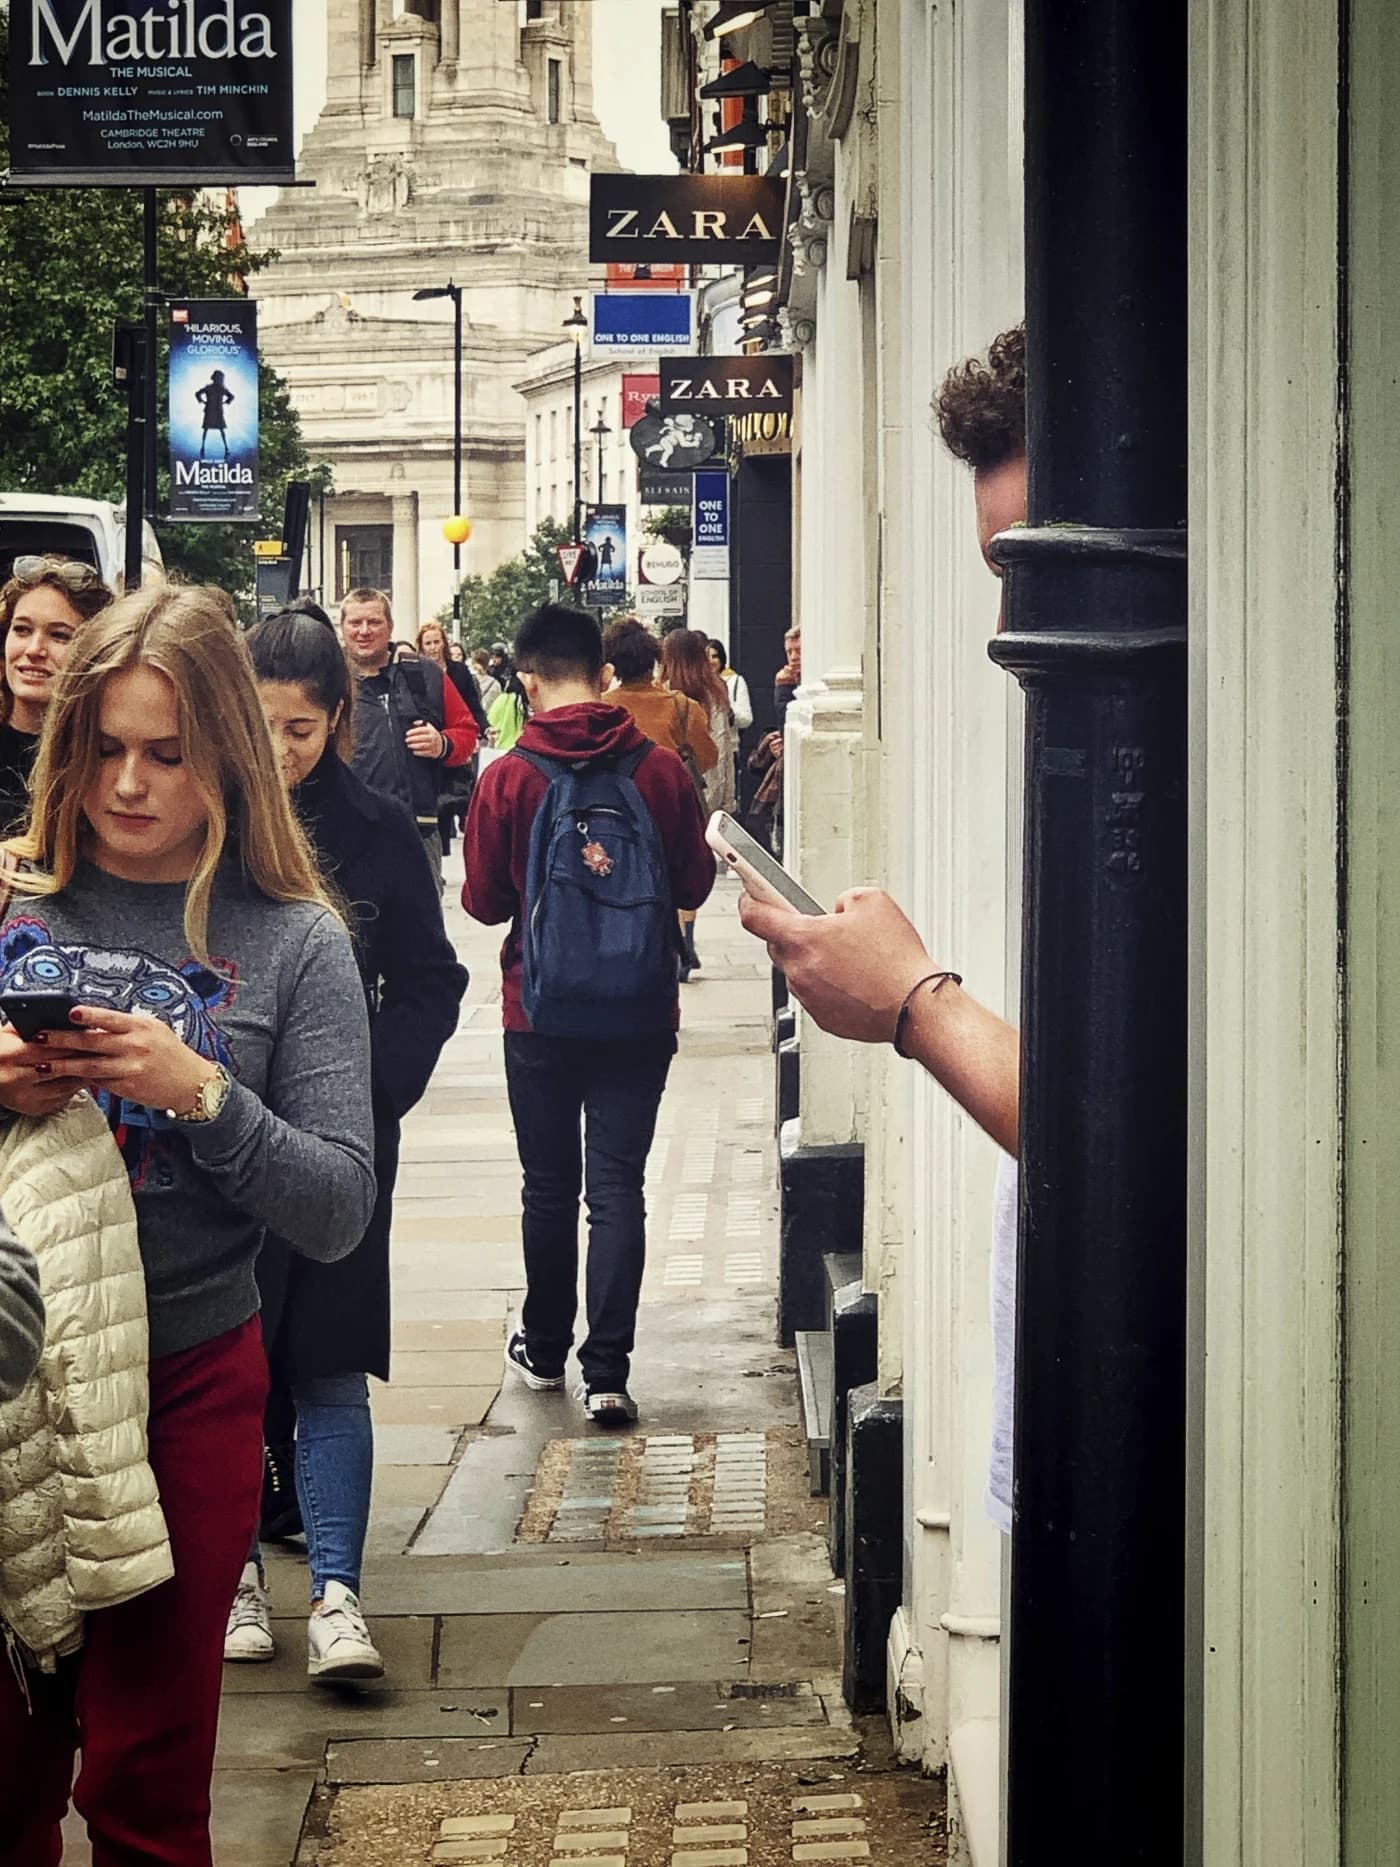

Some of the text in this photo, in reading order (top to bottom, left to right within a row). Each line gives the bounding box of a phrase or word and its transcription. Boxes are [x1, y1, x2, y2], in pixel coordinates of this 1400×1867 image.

[28, 0, 277, 66] Matilda
[110, 66, 192, 78] THE MUSICAL
[57, 87, 100, 97] DENNIS
[103, 86, 138, 96] KELLY
[197, 85, 216, 95] TIM
[220, 84, 268, 95] MINCHIN
[83, 109, 223, 121] MatildaTheMusical.com
[101, 128, 205, 138] CAMBRIDGE THEATRE
[108, 139, 199, 150] London, WC2H 9HU
[605, 210, 776, 240] ZARA
[192, 335, 235, 345] MOVING,
[595, 333, 690, 342] ONE TO ONE ENGLISH
[670, 379, 782, 399] ZARA
[176, 461, 253, 485] Matilda
[699, 501, 722, 511] ONE
[704, 512, 718, 522] TO
[699, 524, 722, 533] ONE
[587, 579, 624, 591] Matilda
